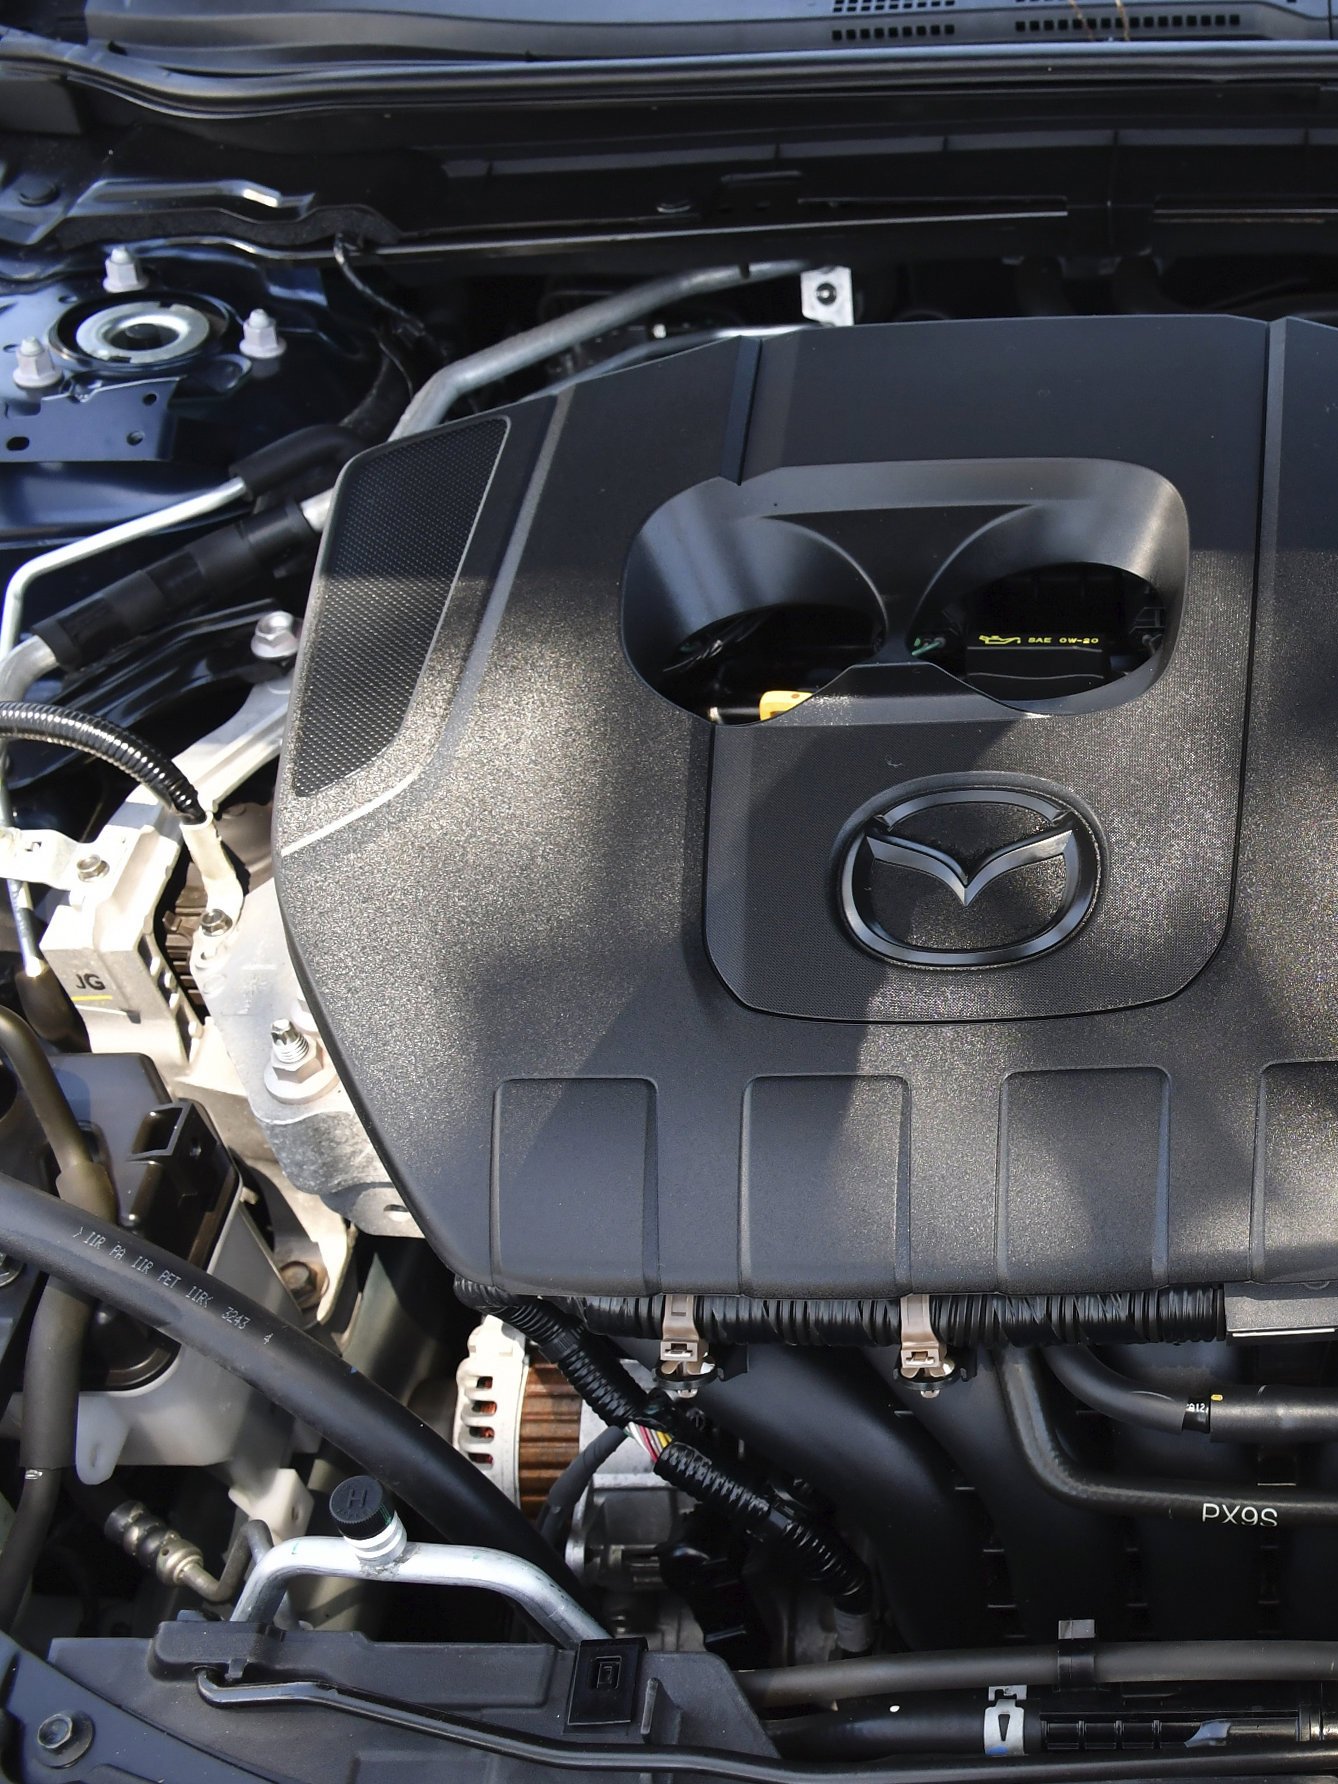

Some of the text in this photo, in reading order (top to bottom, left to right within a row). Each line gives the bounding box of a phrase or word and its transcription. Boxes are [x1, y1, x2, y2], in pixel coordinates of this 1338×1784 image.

[1028, 636, 1053, 644] SAE
[75, 973, 106, 991] JG
[157, 1269, 182, 1289] PET
[1202, 1502, 1279, 1527] PX9S
